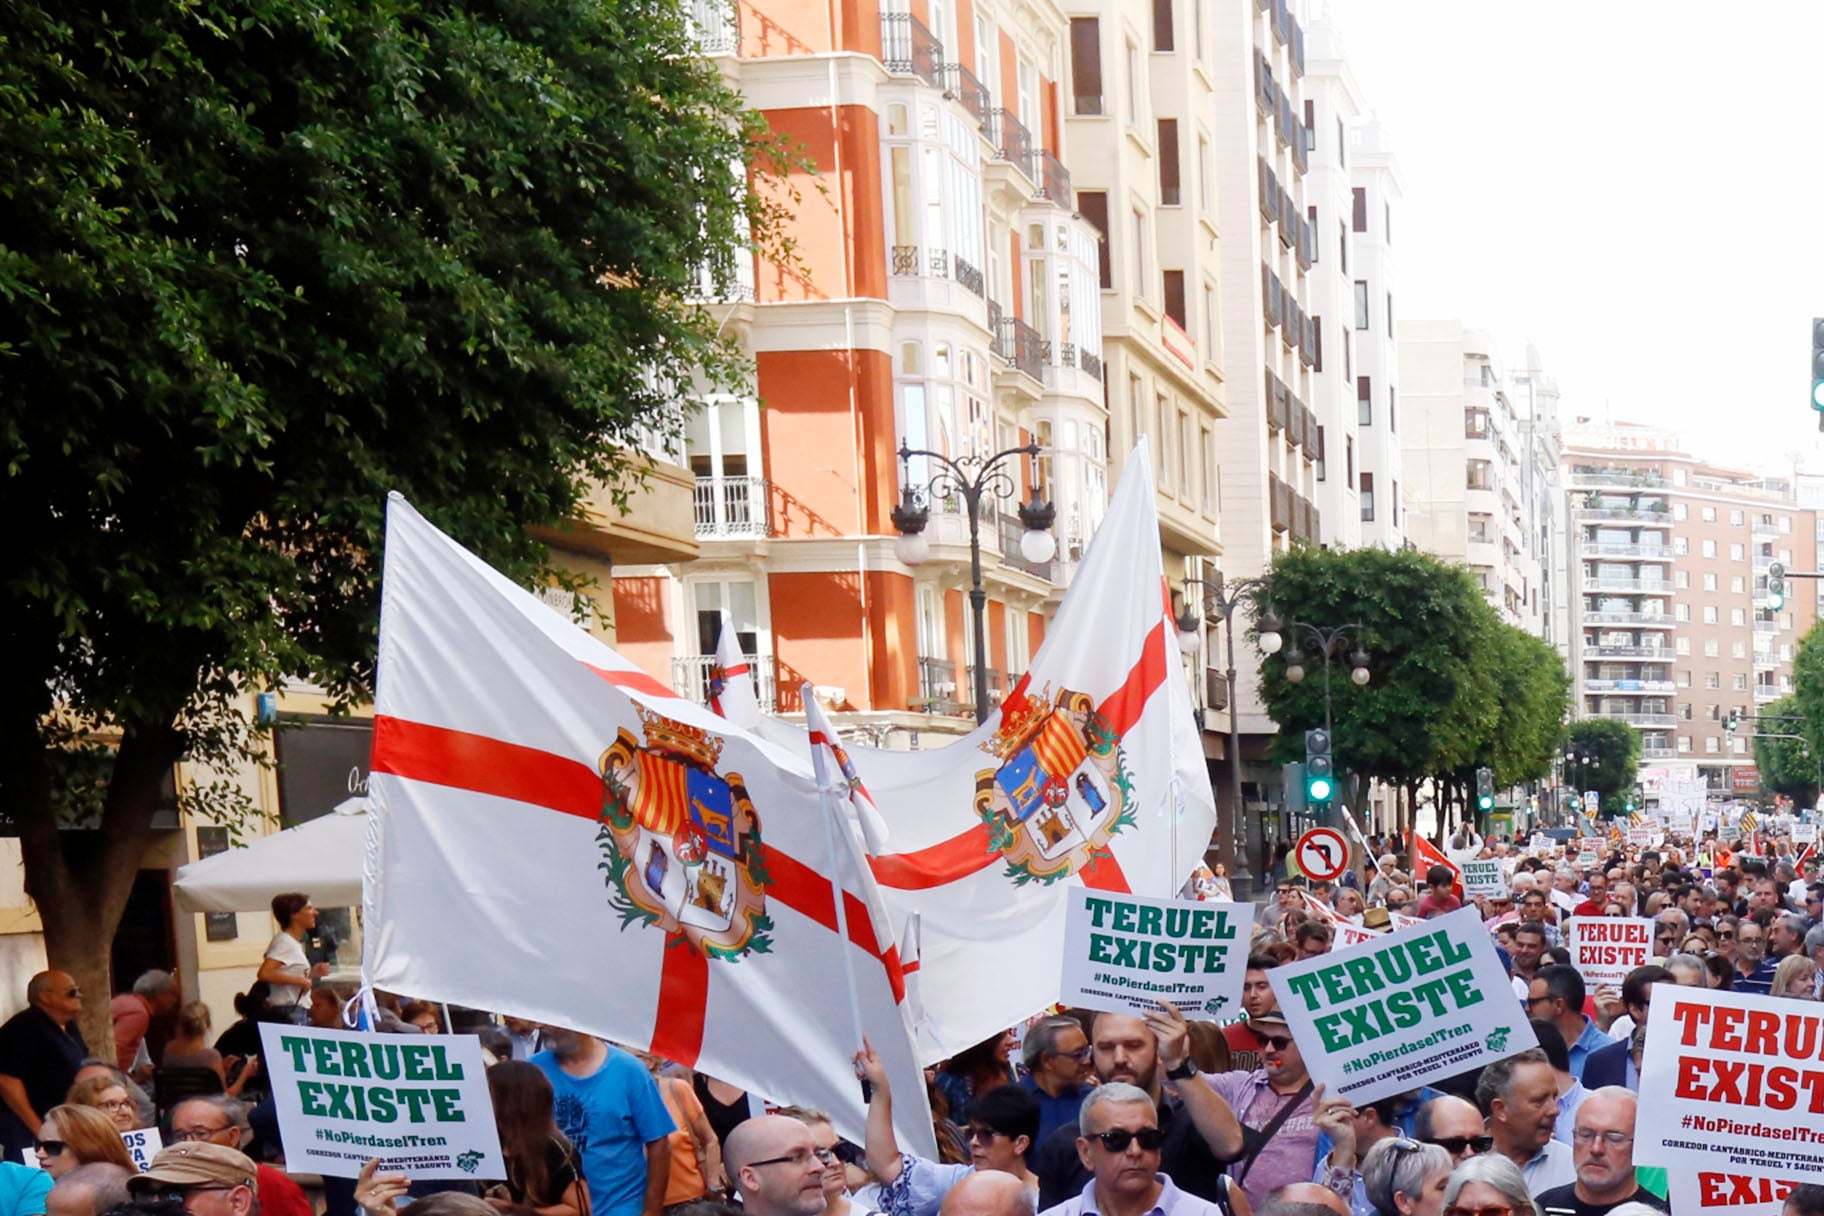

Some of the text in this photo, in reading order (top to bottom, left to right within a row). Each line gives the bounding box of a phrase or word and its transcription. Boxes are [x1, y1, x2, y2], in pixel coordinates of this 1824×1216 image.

[1462, 863, 1498, 873] TERUEL
[1085, 897, 1236, 939] TERUEL
[1578, 923, 1648, 943] TERUEL
[1089, 933, 1228, 973] EXISTE
[1580, 946, 1646, 965] EXISTE
[1094, 973, 1204, 993] #NoPierdaselTren
[1288, 929, 1472, 1011] TERUEL
[1314, 968, 1484, 1054] EXISTE
[281, 1036, 464, 1080] TERUEL
[1342, 1022, 1473, 1074] #NoPierdaselTren
[297, 1080, 465, 1123] EXISTE
[315, 1128, 447, 1148] #NoPierdaselTren
[1662, 1139, 1708, 1151] CORREDOR
[1729, 1155, 1747, 1164] POR
[1750, 1158, 1783, 1169] TERUEL
[1786, 1161, 1791, 1169] Y
